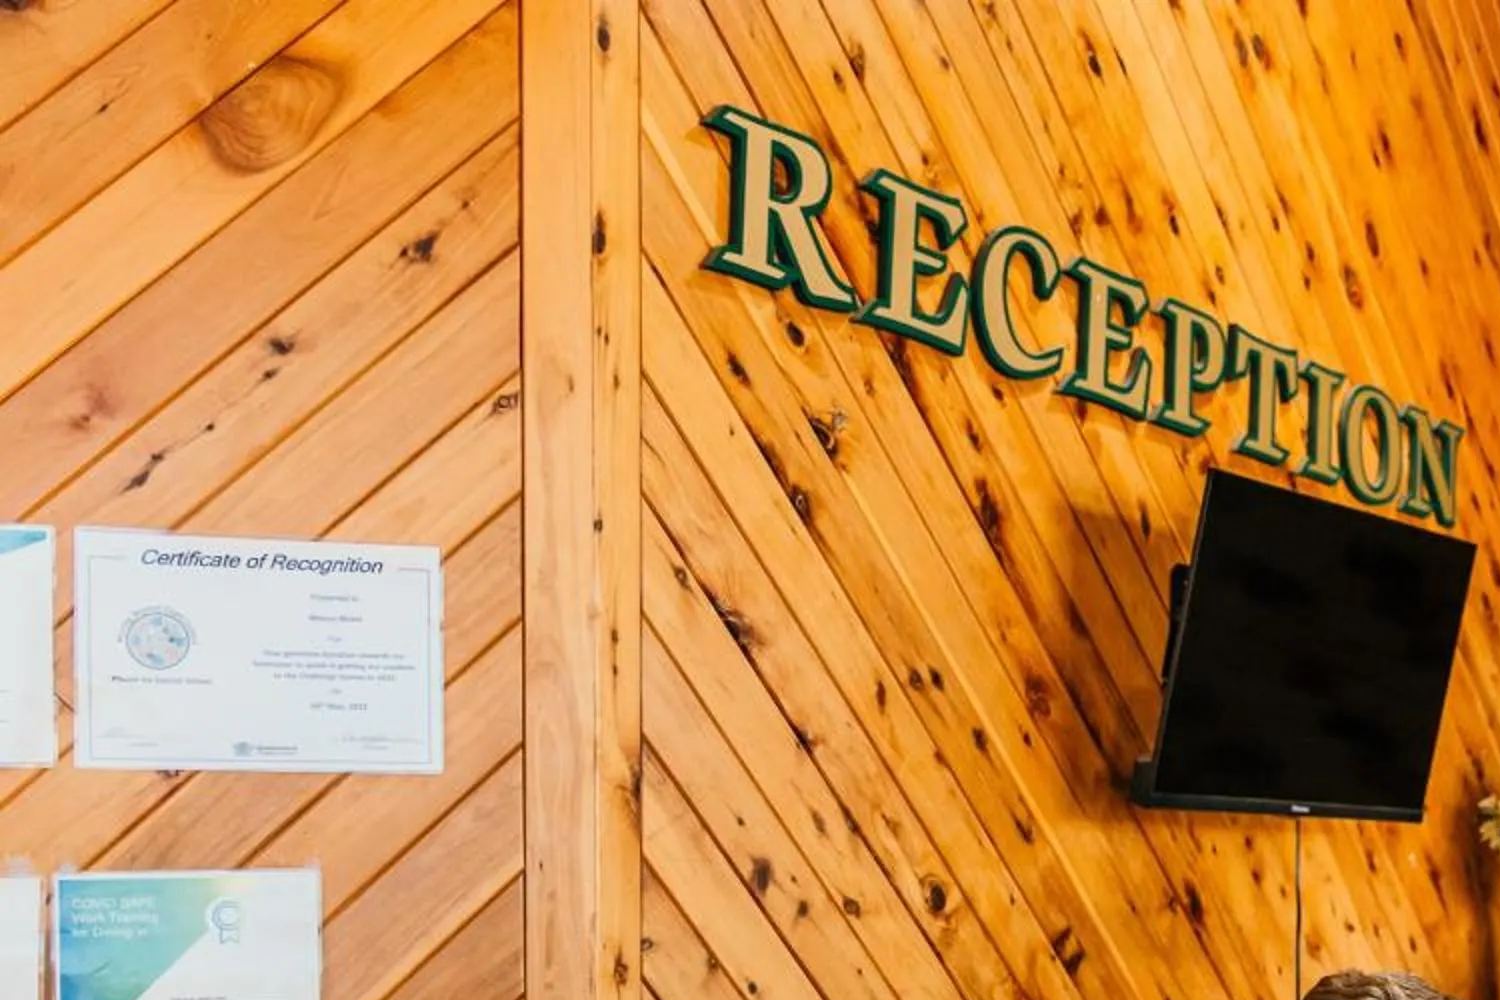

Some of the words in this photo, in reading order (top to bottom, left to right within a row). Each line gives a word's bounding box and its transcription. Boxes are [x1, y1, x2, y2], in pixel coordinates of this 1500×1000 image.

[701, 104, 1465, 528] RECEPTION
[141, 548, 241, 569] Certificate
[247, 553, 269, 570] of
[270, 553, 384, 576] Recognition
